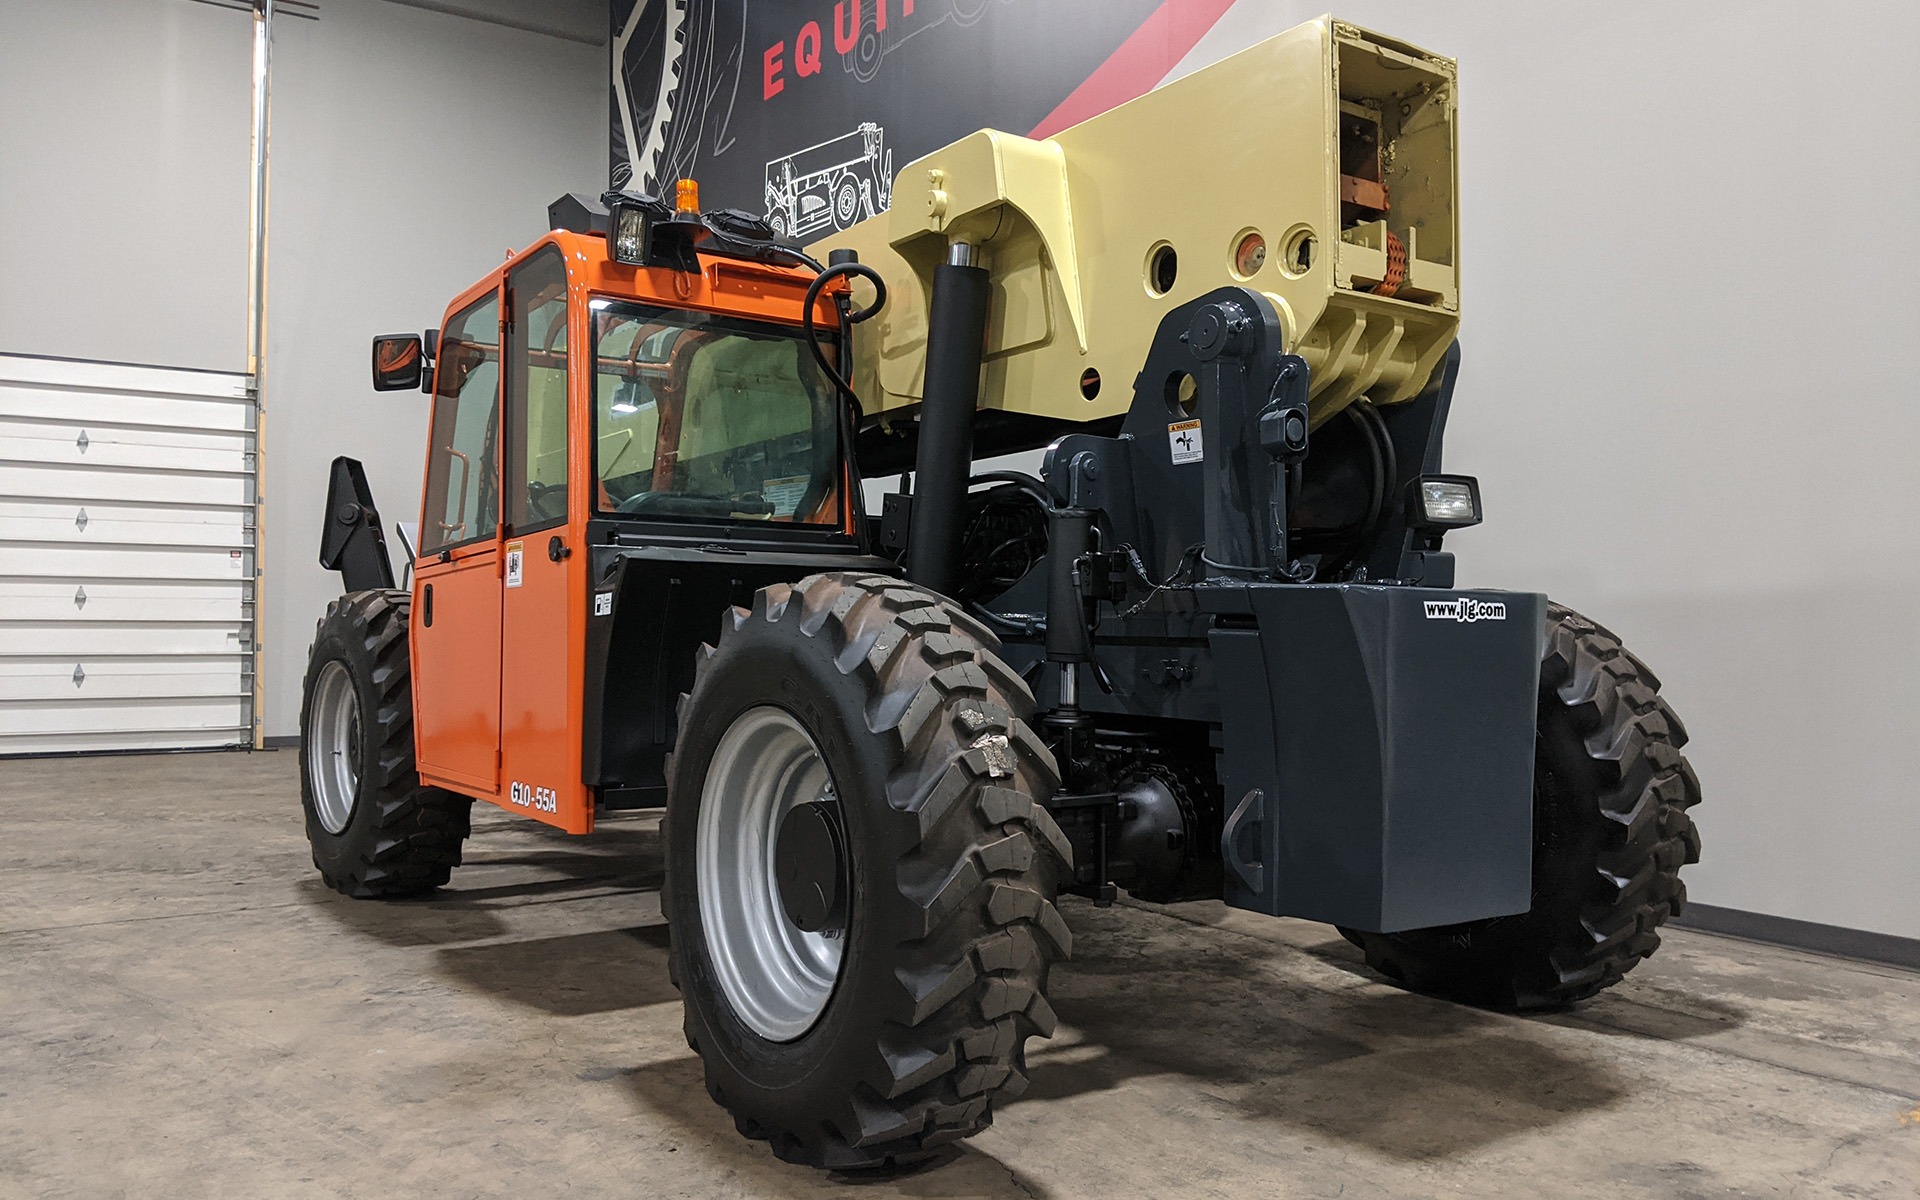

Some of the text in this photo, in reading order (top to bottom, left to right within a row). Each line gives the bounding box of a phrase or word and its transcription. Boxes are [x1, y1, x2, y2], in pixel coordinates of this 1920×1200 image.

[1176, 421, 1198, 430] WARNING
[1426, 600, 1505, 620] www.jlg.com
[510, 780, 557, 814] G10-55A
